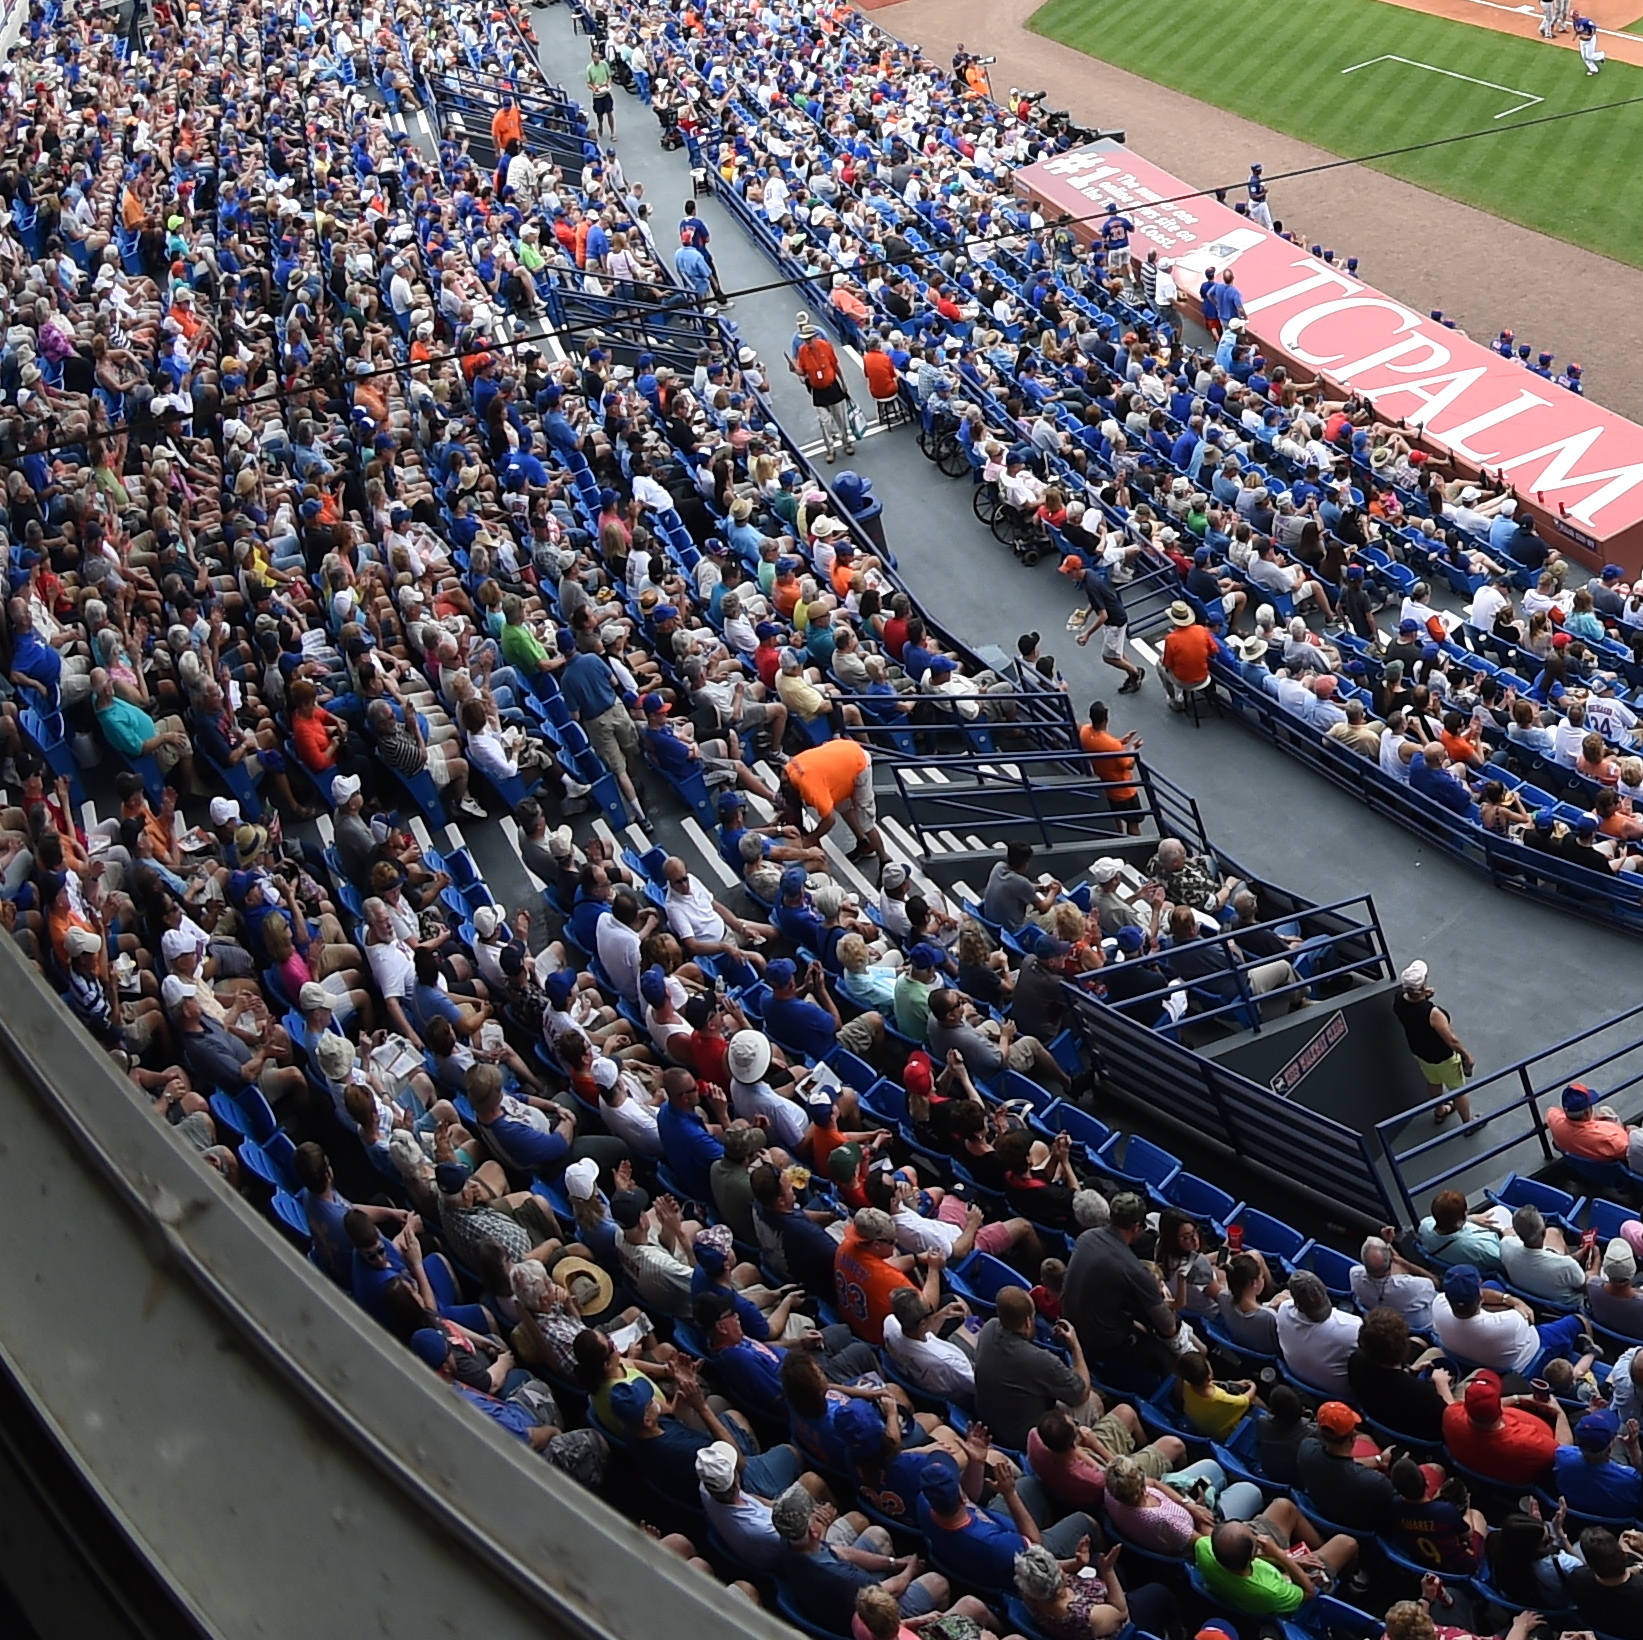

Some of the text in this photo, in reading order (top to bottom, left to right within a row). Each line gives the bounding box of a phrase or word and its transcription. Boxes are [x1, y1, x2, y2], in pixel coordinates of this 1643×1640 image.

[1042, 151, 1121, 190] #1
[1081, 186, 1176, 250] the Coast.
[1098, 181, 1135, 204] online
[1154, 215, 1181, 233] site
[1176, 230, 1197, 243] on
[1116, 172, 1199, 225] The one
[836, 1271, 869, 1321] 33
[1401, 1517, 1435, 1533] SUAREZ
[1418, 1536, 1442, 1565] 9
